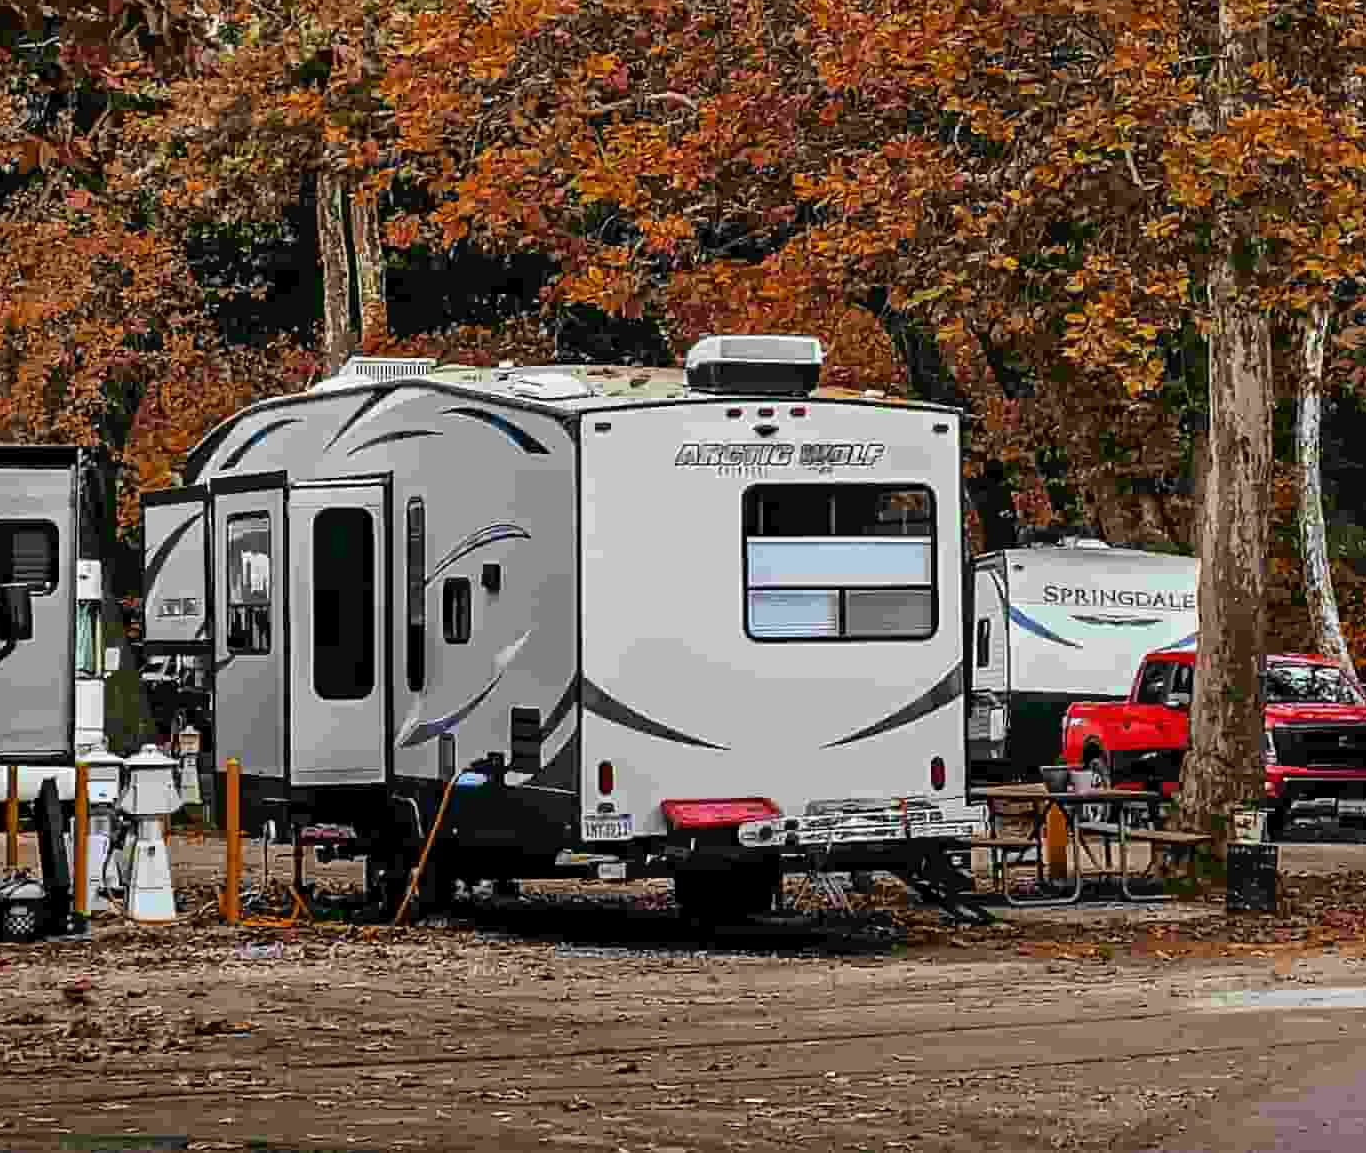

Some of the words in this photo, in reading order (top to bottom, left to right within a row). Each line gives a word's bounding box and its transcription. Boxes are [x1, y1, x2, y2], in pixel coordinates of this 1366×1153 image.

[674, 443, 796, 468] ARCTIC
[801, 443, 886, 468] WOLF
[1043, 584, 1196, 609] SPRINGDALE
